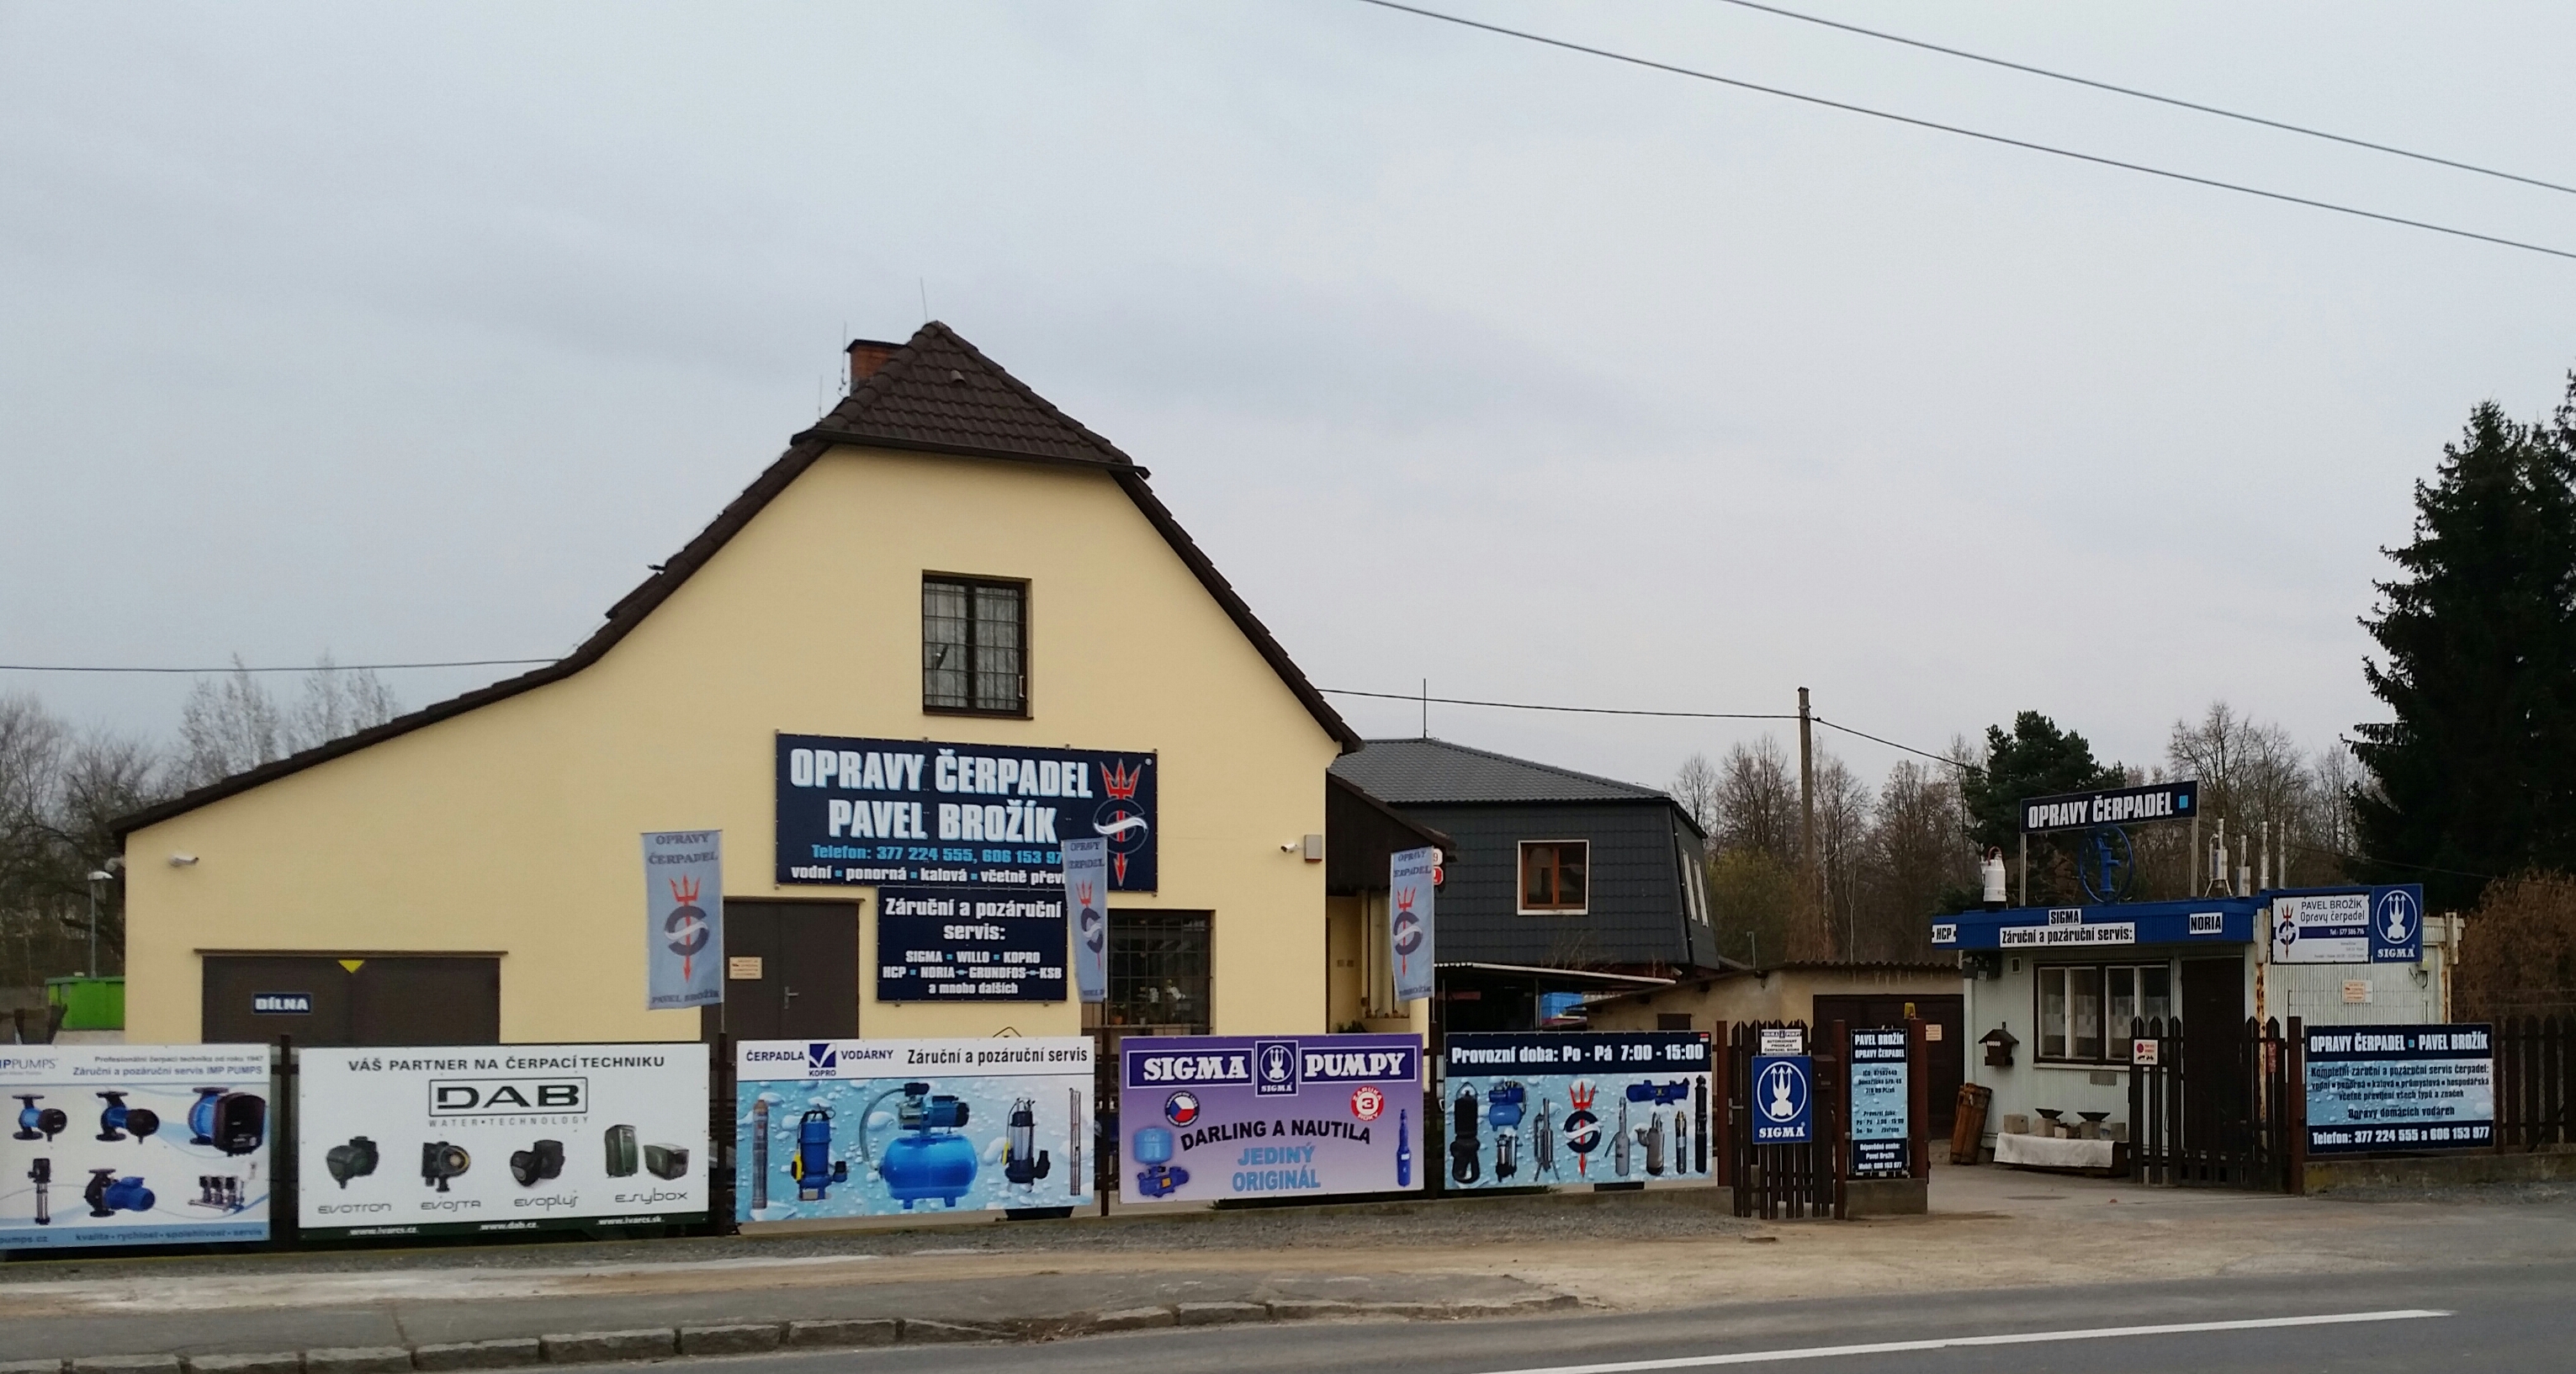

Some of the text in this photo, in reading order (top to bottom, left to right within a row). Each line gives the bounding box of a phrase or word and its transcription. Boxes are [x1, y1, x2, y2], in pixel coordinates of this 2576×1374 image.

[790, 747, 1093, 799] OPRAVY ČERPADEL
[2028, 791, 2173, 828] OPRAVY ČERPADEL
[828, 799, 1058, 844] PAVEL BROŽÍK
[656, 833, 709, 845] OPRAVY
[648, 851, 718, 865] ČERPADEL
[811, 844, 1042, 865] Telefon: 377 224 555, 606 153
[1397, 850, 1427, 862] OPRAVY
[791, 865, 1026, 883] vodní ponorná kalová včetně
[885, 897, 1062, 919] Záruční a pozáruční
[2301, 898, 2362, 910] PAVEL BROŽÍK
[2050, 910, 2079, 925] SIGMA
[2191, 915, 2221, 931] NORIA
[2300, 910, 2365, 924] Opravy čerpadel
[943, 922, 1006, 941] servis:
[1936, 927, 1952, 941] HCP
[2002, 926, 2133, 945] Záruční a pozáruční servis:
[905, 950, 1041, 964] SIGMA WILLO KOPRO
[2377, 947, 2414, 958] SIGMA
[883, 966, 1062, 979] HCP NORIA GRUNDFOS KSB
[928, 983, 1018, 995] a mnoho dalších
[255, 996, 308, 1011] DÍLNA
[1854, 1032, 1905, 1046] PAVEL BROŽÍK
[2310, 1031, 2489, 1053] OPRAVY ČERPADEL PAVEL BROŽÍK
[745, 1047, 894, 1062] ČERPADLA VODÁRNY
[907, 1046, 1088, 1067] Záruční a pozáruční servis
[1451, 1046, 1516, 1064] Provozní
[1519, 1045, 1558, 1064] doba:
[1562, 1045, 1582, 1062] Po
[1593, 1044, 1614, 1062] Pá
[1620, 1044, 1652, 1061] 7:00
[1664, 1043, 1704, 1060] 15:00
[1854, 1047, 1905, 1058] OPRAVY ČERPADEL
[348, 1055, 665, 1071] VÁŠ PARTNER NA ČERPACÍ TECHNIKU
[1143, 1053, 1406, 1081] SIGMA PUMPY
[72, 1065, 111, 1075] Záruční
[123, 1066, 172, 1077] pozáruční
[174, 1067, 204, 1075] servis
[226, 1066, 263, 1074] PUMPS
[2311, 1065, 2349, 1078] Kompletní
[2351, 1065, 2381, 1076] záruční
[2389, 1064, 2427, 1077] pozáruční
[2429, 1064, 2452, 1074] servis
[2454, 1064, 2489, 1076] čerpadel:
[1261, 1084, 1292, 1093] SIGMA
[2312, 1081, 2330, 1090] vodní
[2372, 1079, 2394, 1089] kalová
[2401, 1079, 2440, 1089] průmyslová
[2446, 1078, 2489, 1087] hospodářská
[437, 1085, 579, 1110] DAB
[2441, 1089, 2464, 1098] značek
[1361, 1097, 1375, 1110] 3
[2348, 1106, 2455, 1120] Opravy domácích vodáren
[1180, 1120, 1267, 1152] DARLING
[1272, 1119, 1285, 1136] A
[1291, 1119, 1371, 1145] NAUTILA
[1758, 1127, 1805, 1138] SIGMA
[2313, 1126, 2490, 1145] Telefon: 377 224 555 a 606 153 977
[1238, 1142, 1316, 1166] JEDINÝ
[1232, 1164, 1321, 1192] ORIGINÁL
[480, 1221, 537, 1231] www.dab.cz
